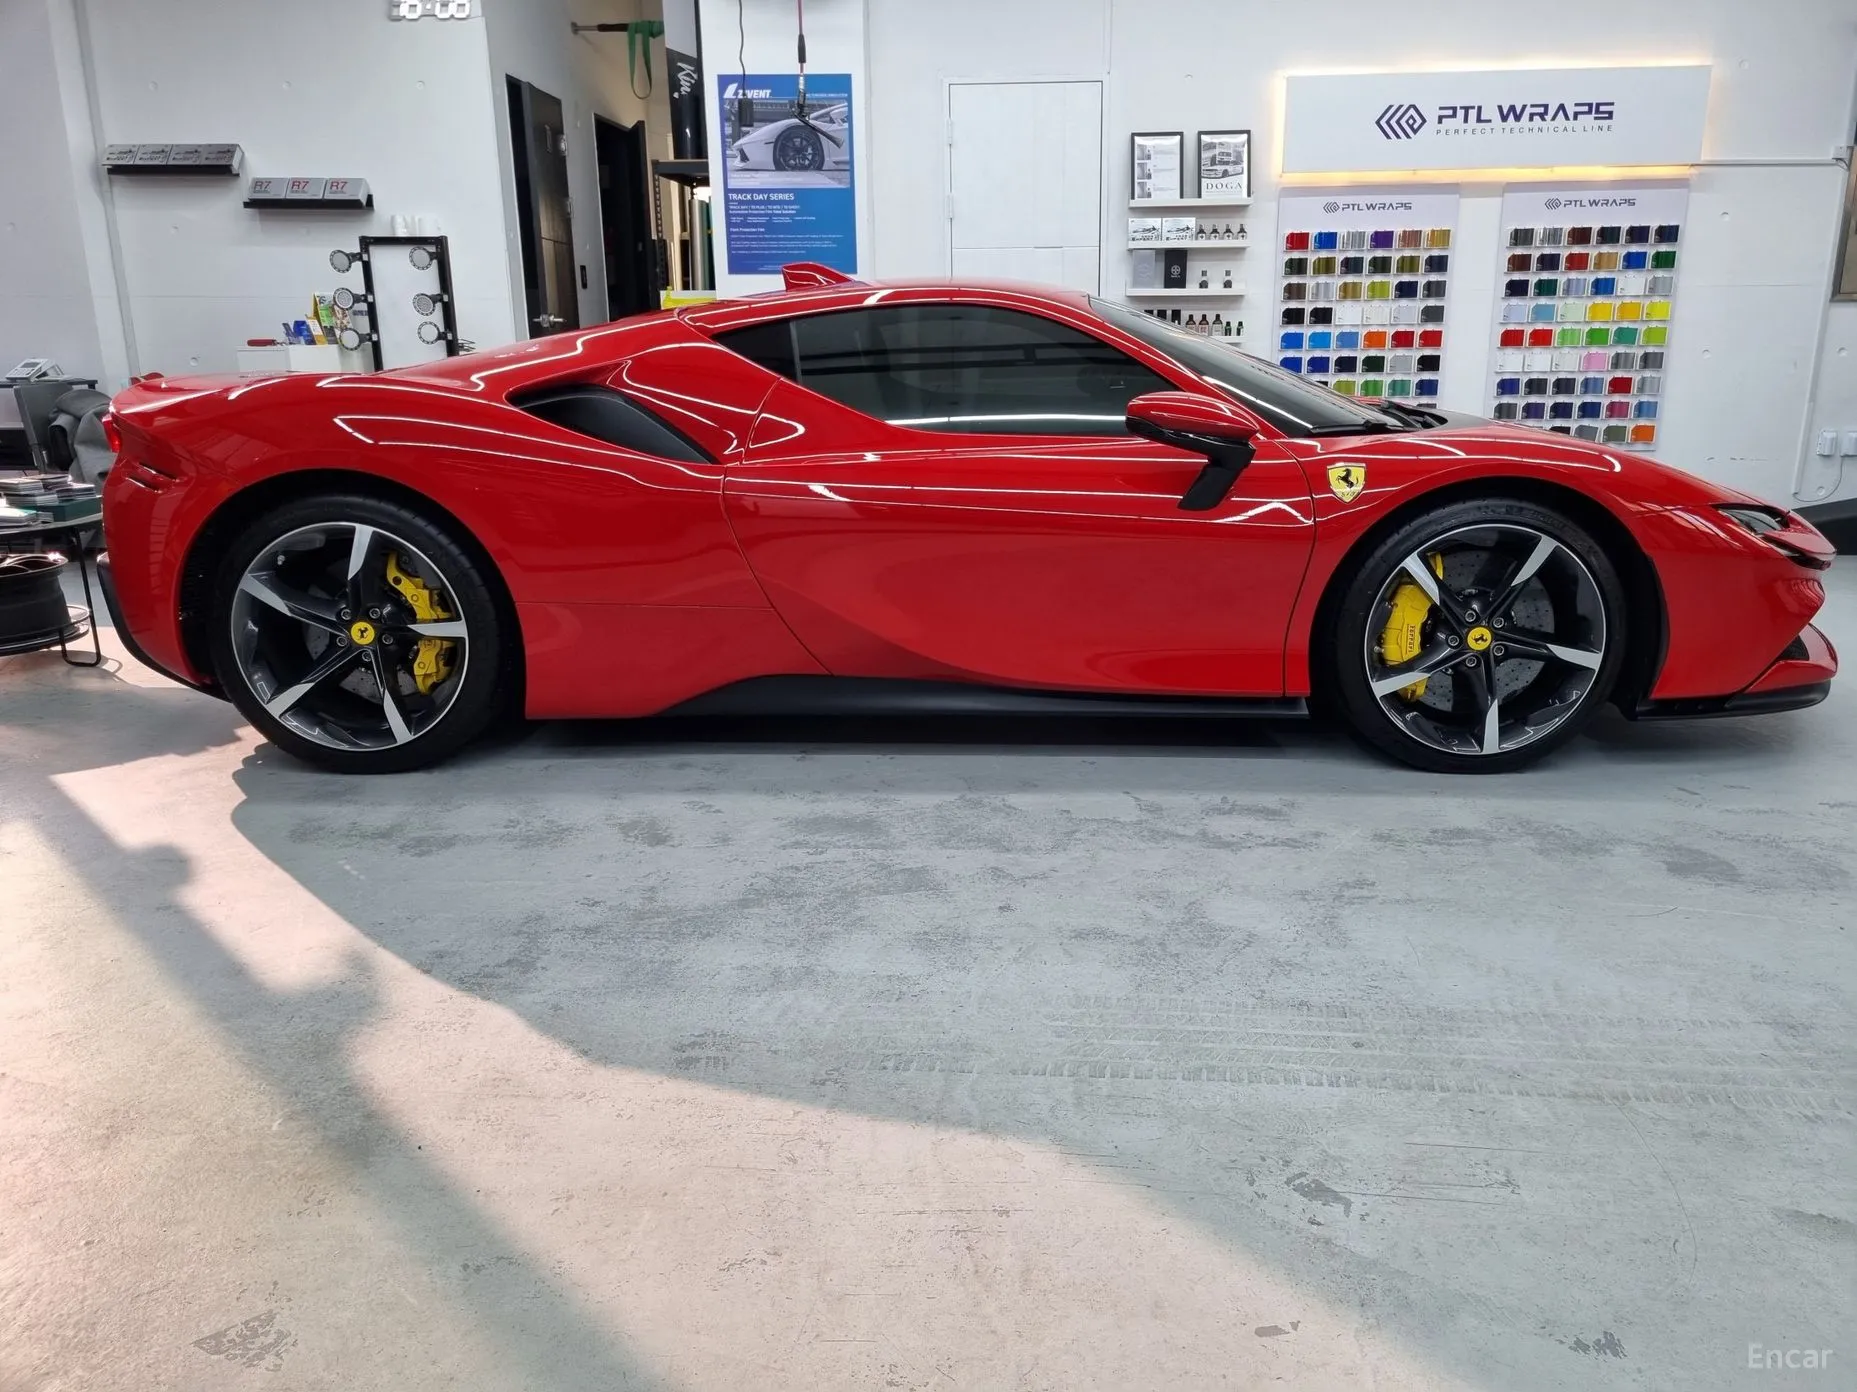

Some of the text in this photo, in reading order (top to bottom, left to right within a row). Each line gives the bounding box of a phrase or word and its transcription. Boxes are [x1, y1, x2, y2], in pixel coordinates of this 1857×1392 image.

[737, 89, 772, 98] ZVENT
[1437, 102, 1616, 125] PTL WRAPS
[1436, 124, 1613, 136] PERFECT TECHNICAL LINE
[253, 180, 272, 190] R7
[291, 180, 310, 190] R7
[330, 180, 348, 190] R7
[728, 193, 752, 201] TRACK
[1341, 202, 1413, 211] PTL WRAPS
[1563, 198, 1637, 208] PTL WRAPS
